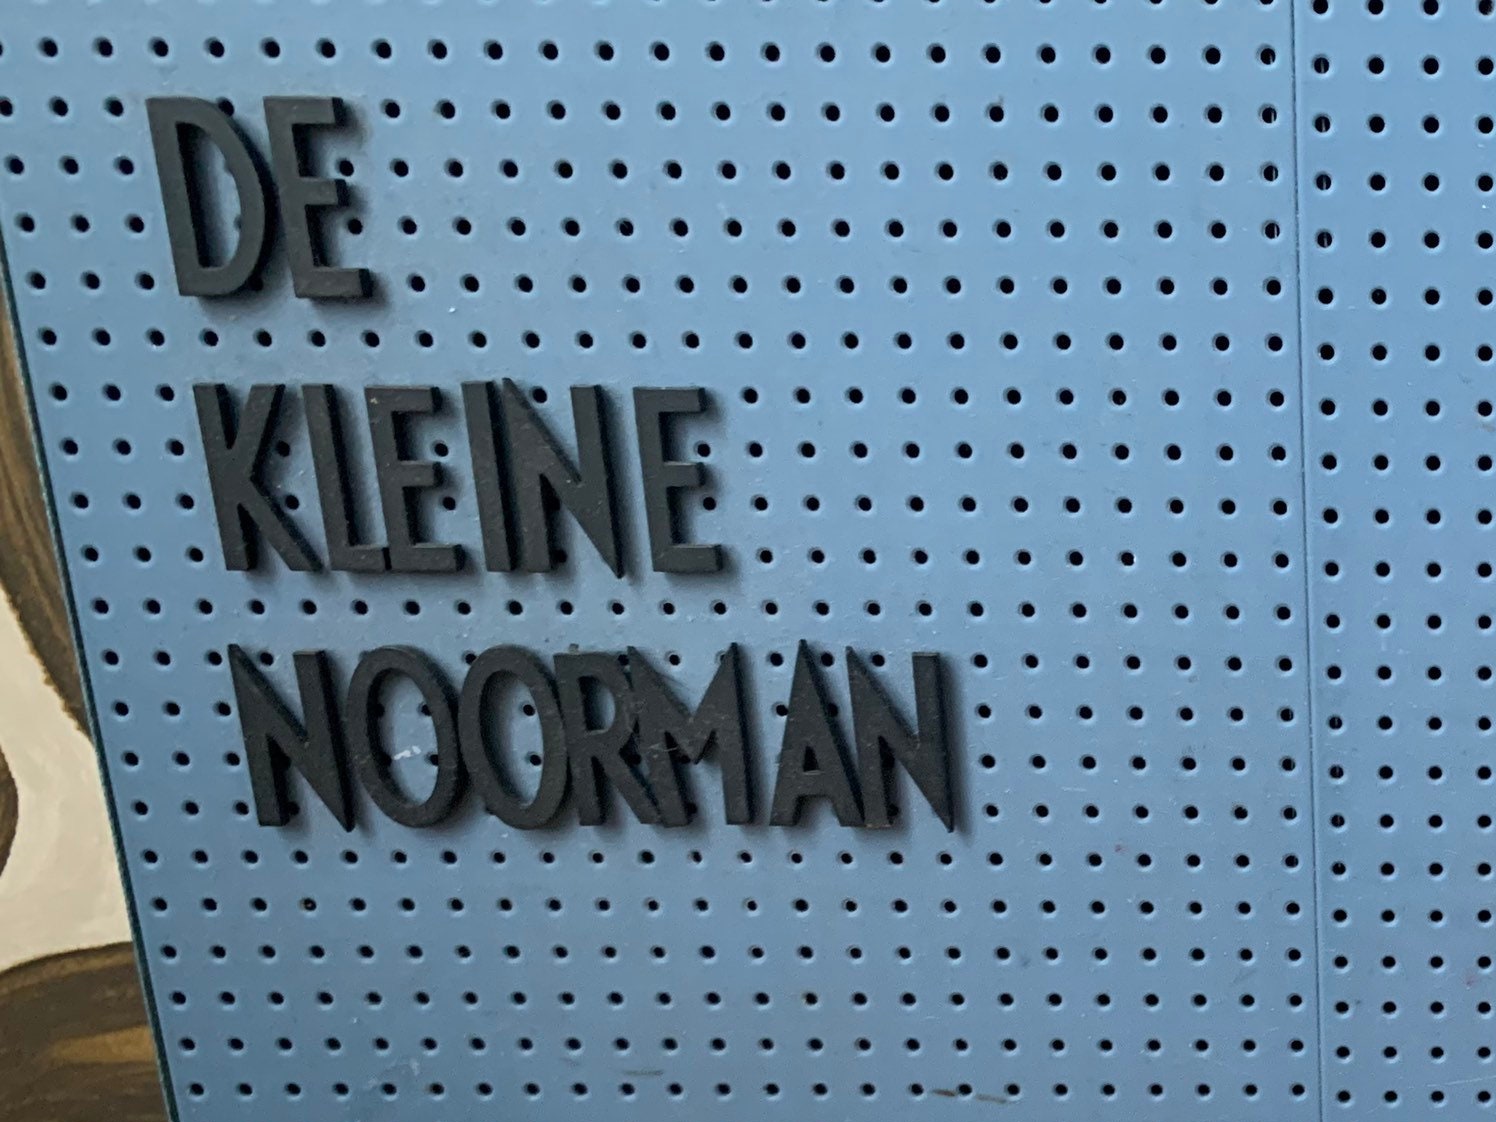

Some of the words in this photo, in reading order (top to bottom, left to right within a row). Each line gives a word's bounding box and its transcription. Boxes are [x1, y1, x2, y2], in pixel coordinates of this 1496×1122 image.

[146, 96, 372, 298] DE
[192, 378, 724, 578] KLEINE
[228, 640, 957, 833] NOORMAN
